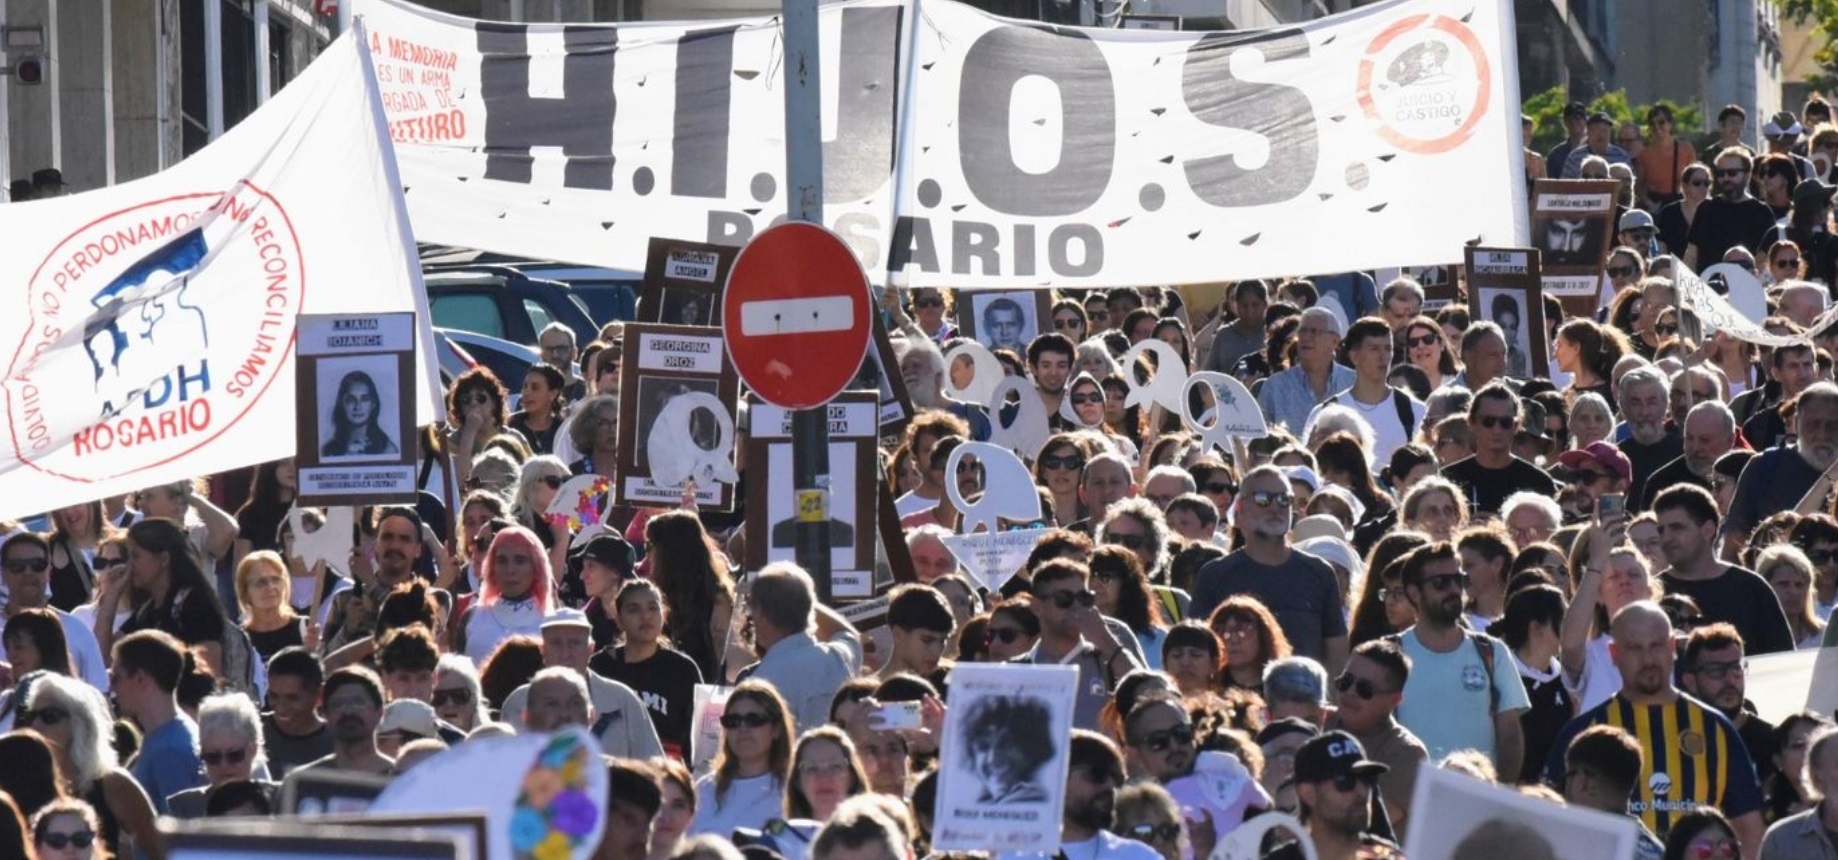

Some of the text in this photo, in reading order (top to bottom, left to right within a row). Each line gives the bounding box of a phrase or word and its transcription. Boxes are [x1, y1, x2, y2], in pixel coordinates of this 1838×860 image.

[370, 31, 457, 72] A MEMORIA
[378, 64, 451, 90] ES UN ARMA
[383, 88, 457, 112] RGADA DE
[1399, 89, 1457, 107] JUICIO Y
[1396, 104, 1462, 122] CASTIGO
[389, 109, 466, 144] UTURO
[708, 210, 1104, 278] RSARIO
[226, 216, 287, 399] RECONCILIAMOS
[650, 339, 710, 354] GEORGINA
[664, 355, 696, 368] DROZ
[74, 398, 211, 457] ROSARIO
